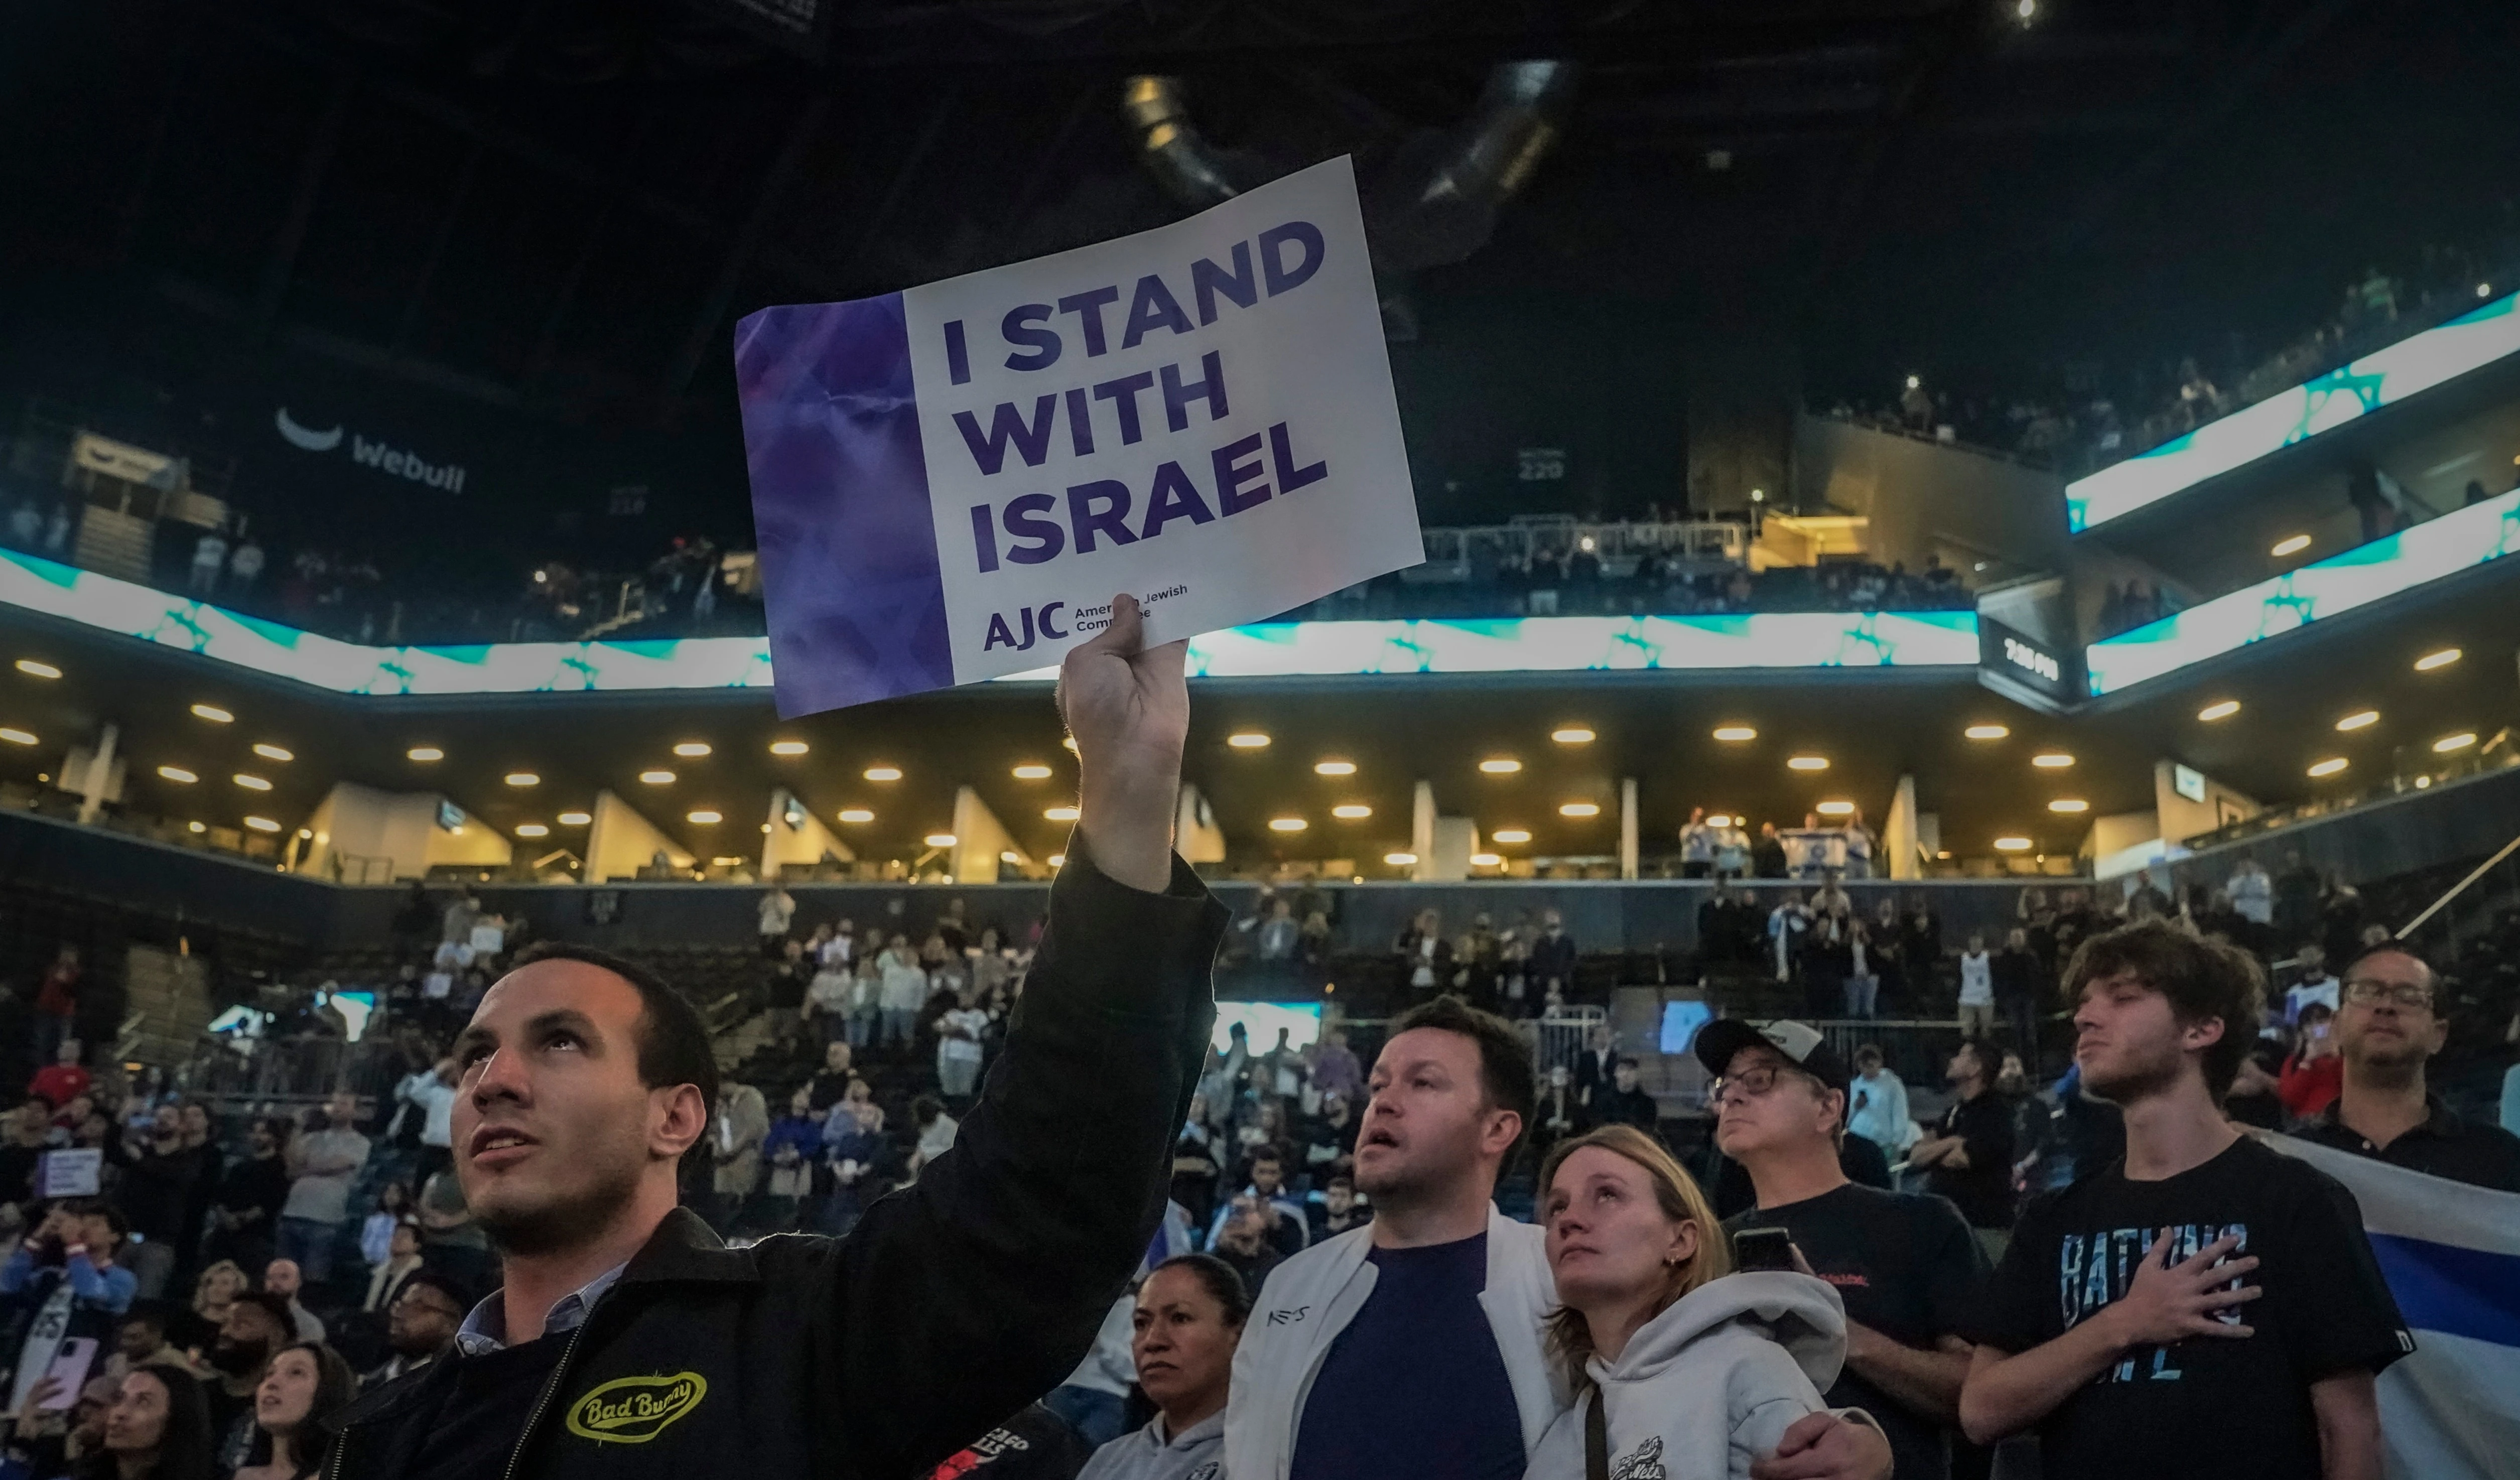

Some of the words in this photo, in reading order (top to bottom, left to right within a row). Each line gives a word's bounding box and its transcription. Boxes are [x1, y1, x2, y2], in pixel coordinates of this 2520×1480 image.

[943, 319, 971, 385] I
[1000, 221, 1325, 372] STAND
[951, 349, 1230, 476] WITH
[353, 434, 465, 494] Webull
[970, 421, 1328, 574] ISRAEL
[1075, 599, 1139, 619] Amern
[1144, 584, 1188, 604] Jewish
[1076, 608, 1151, 632] Comee
[984, 602, 1069, 651] AJC
[585, 1397, 633, 1425] Bad
[635, 1381, 691, 1416] Bunny
[1628, 1461, 1664, 1480] Nets
